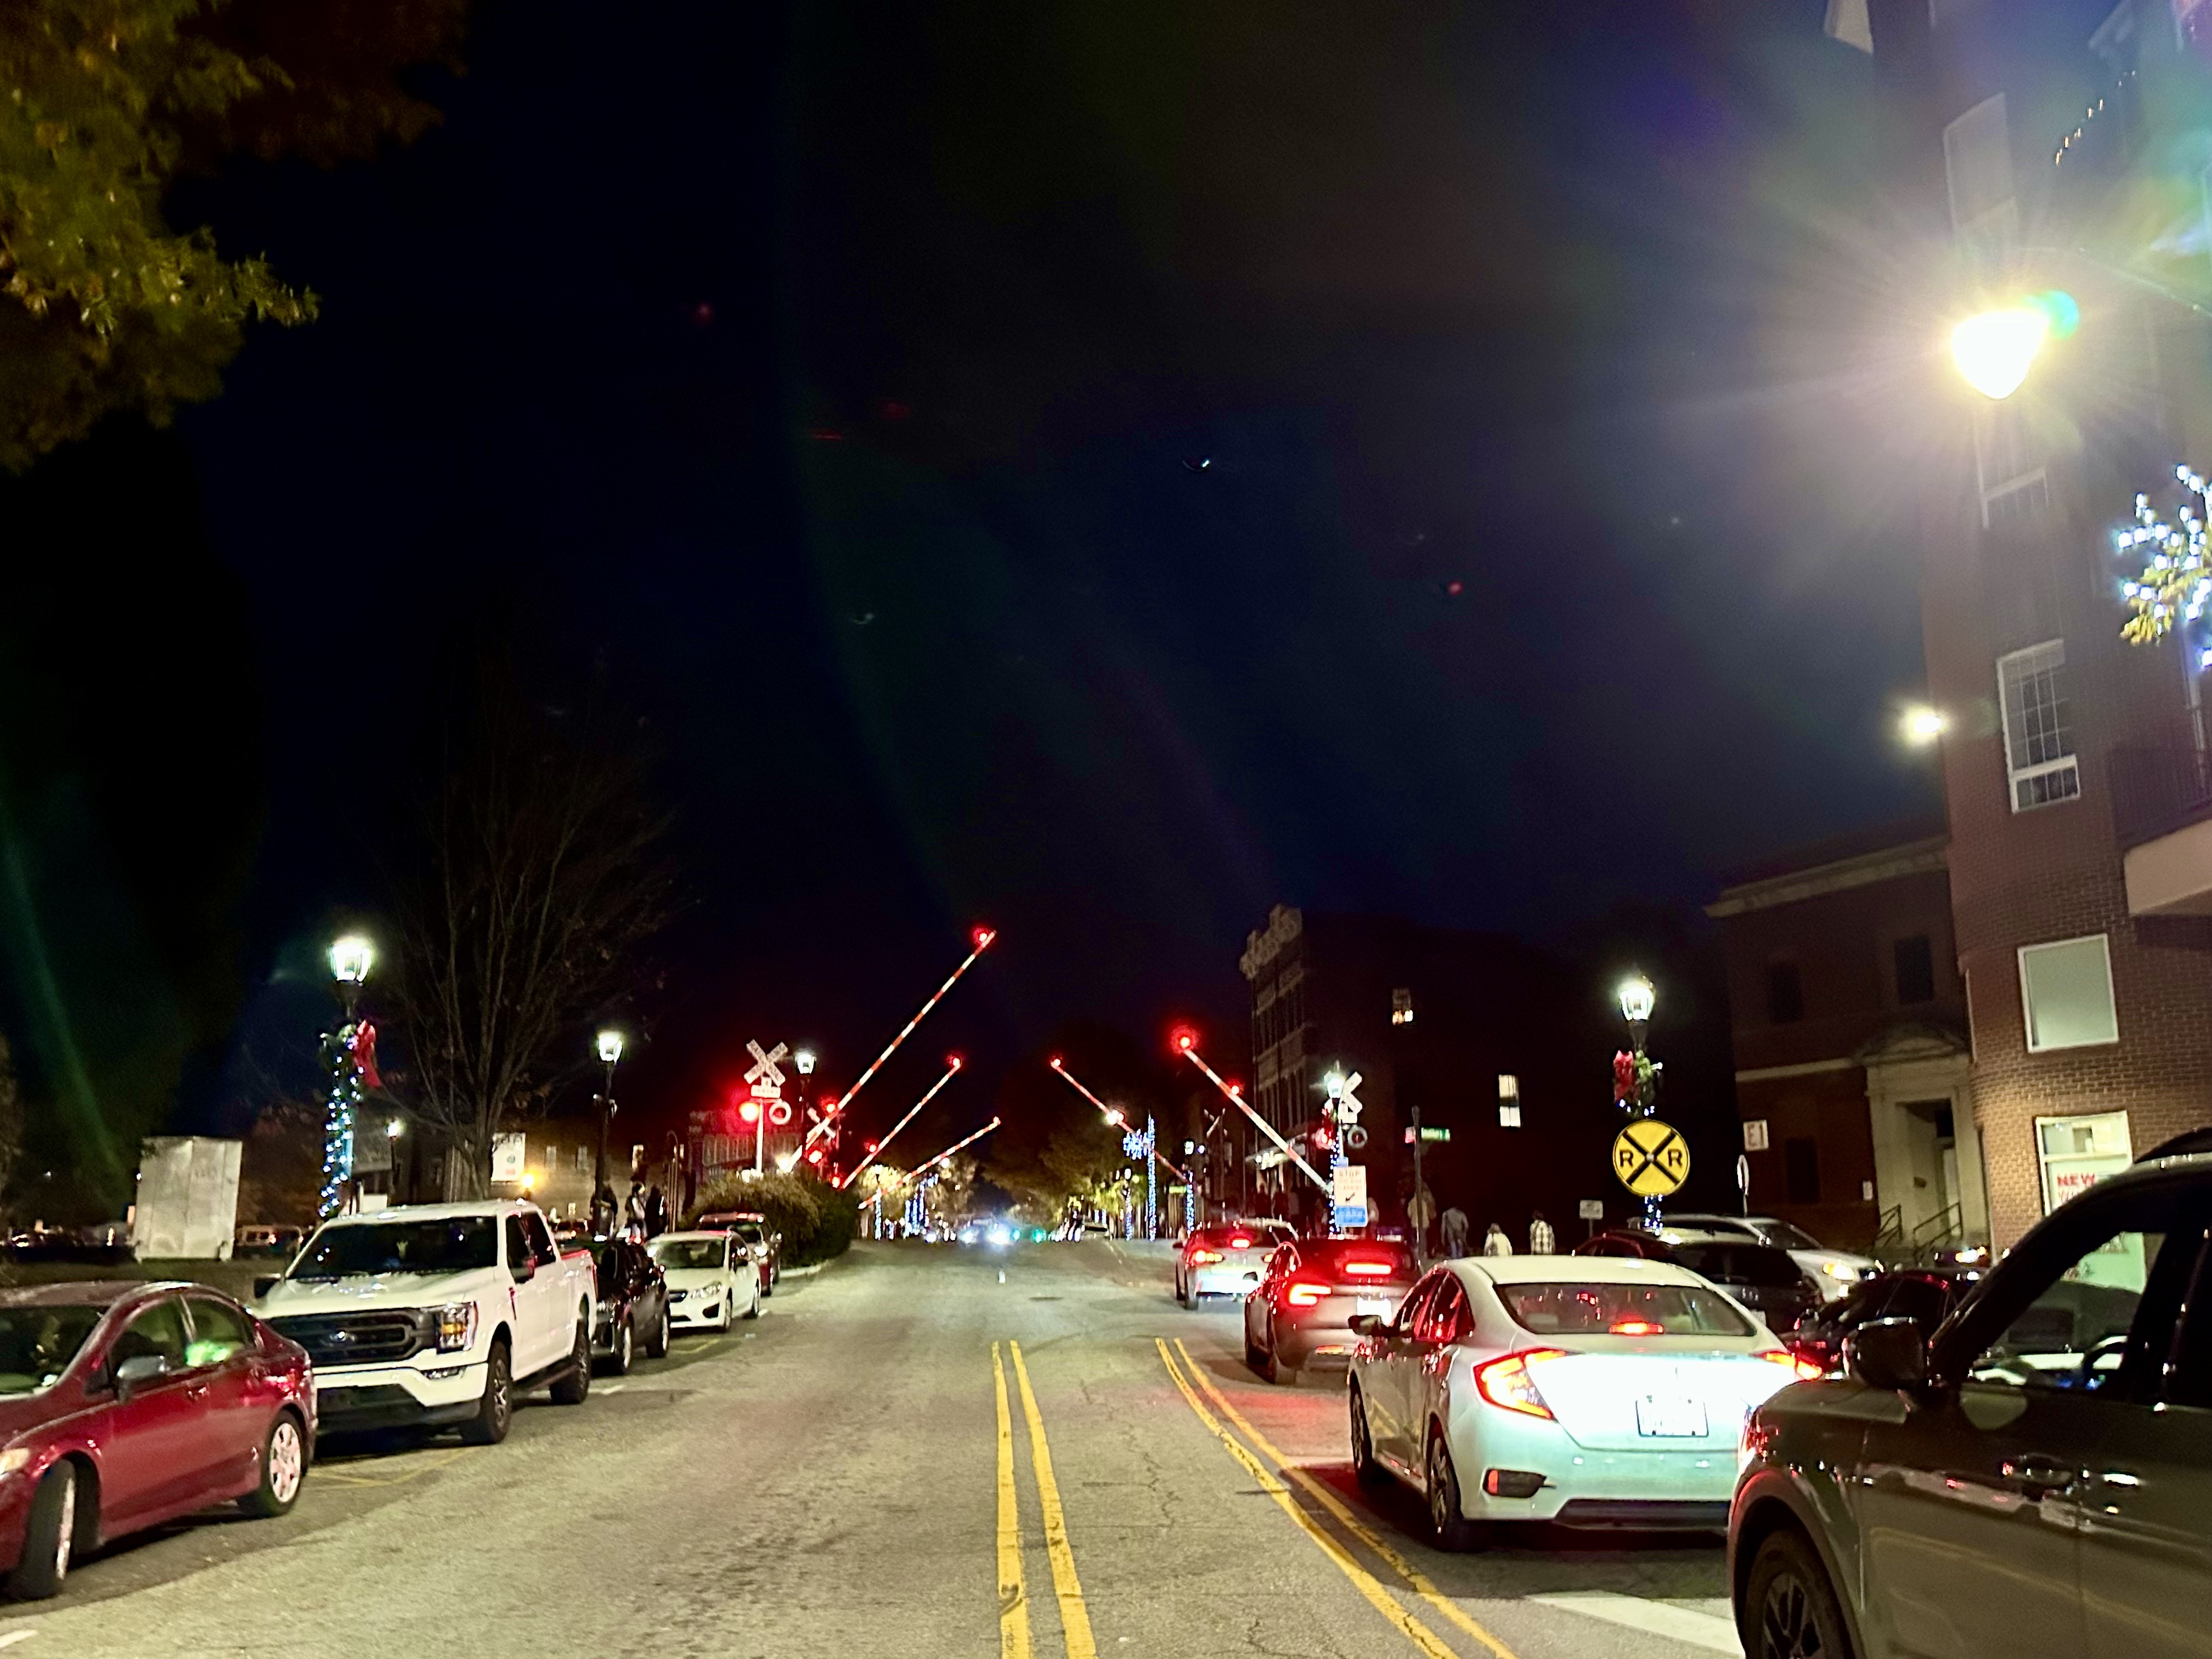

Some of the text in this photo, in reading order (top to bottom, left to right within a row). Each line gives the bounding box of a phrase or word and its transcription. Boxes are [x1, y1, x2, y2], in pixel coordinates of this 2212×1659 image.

[1619, 1148, 1683, 1167] R R
[2057, 1173, 2095, 1187] NEW
